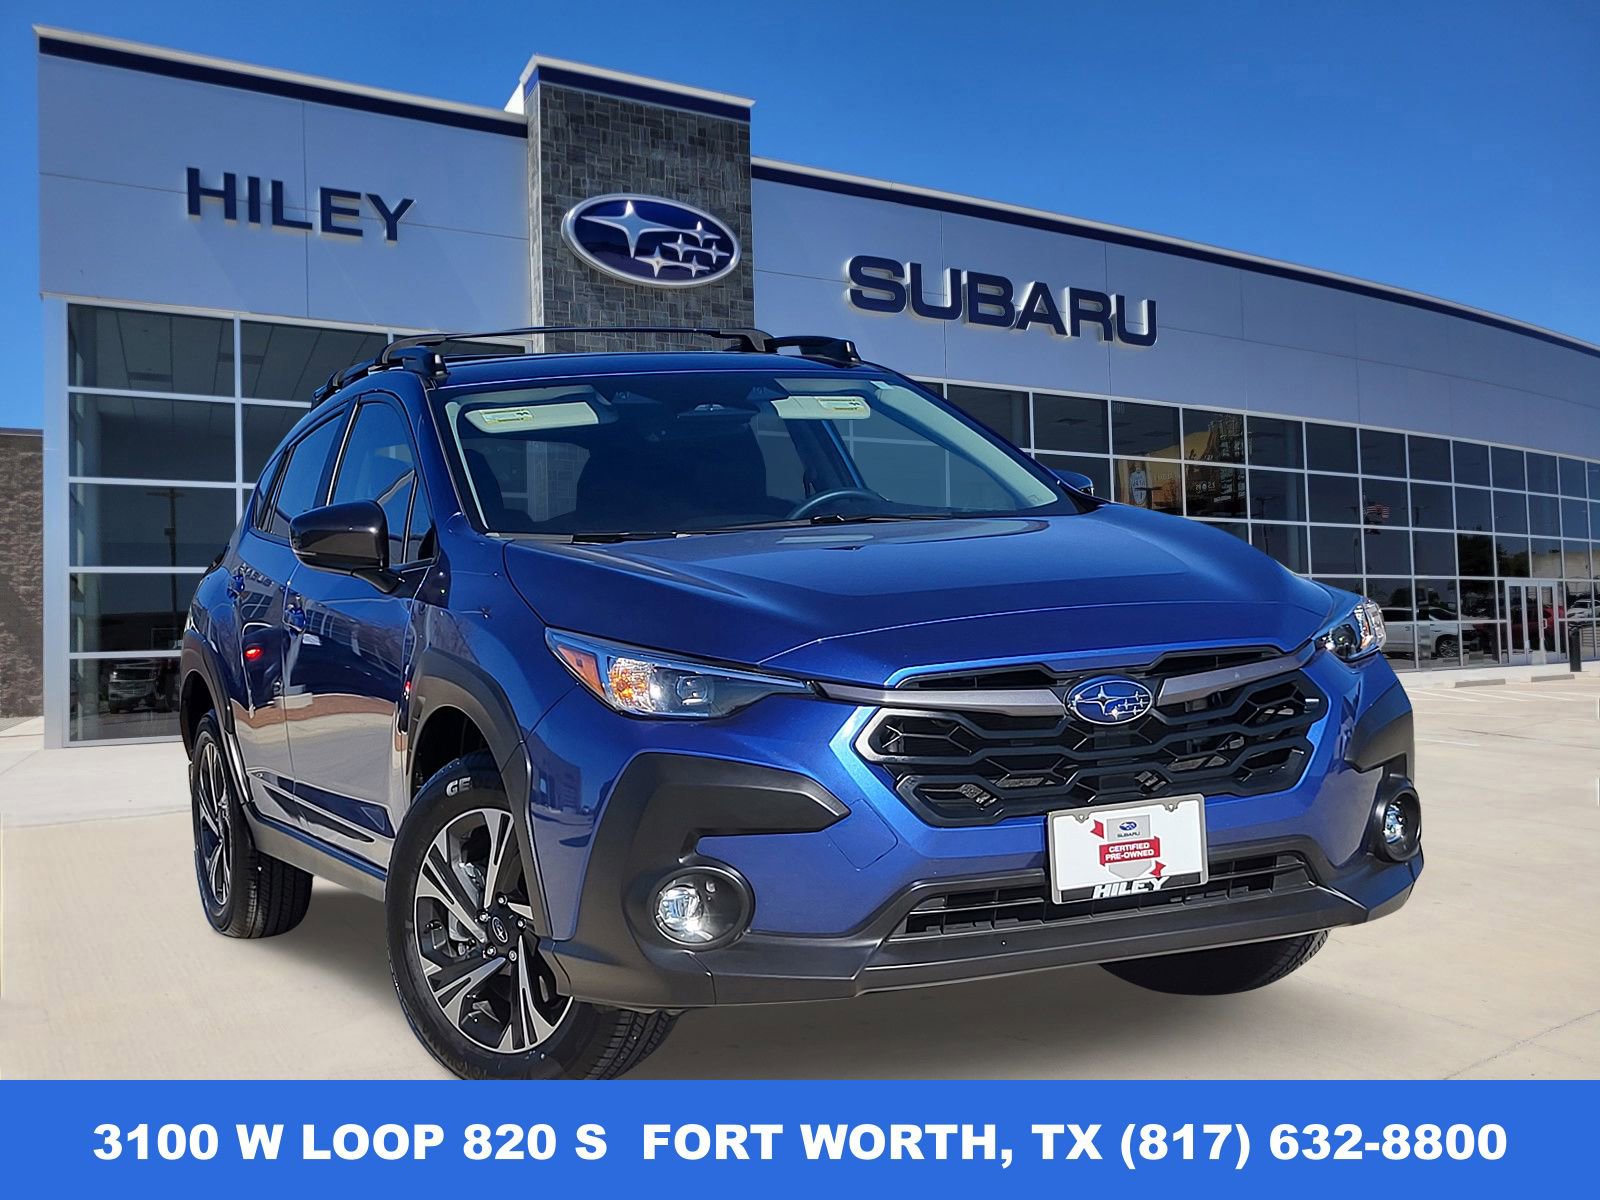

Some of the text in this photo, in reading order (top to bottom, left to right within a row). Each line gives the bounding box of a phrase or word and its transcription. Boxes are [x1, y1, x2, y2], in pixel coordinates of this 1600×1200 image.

[186, 168, 414, 241] HILEY
[847, 255, 1157, 347] SUBARU
[1105, 849, 1154, 861] PRE-OWNED
[1108, 842, 1150, 852] CERTIFIED
[1093, 876, 1170, 899] HILEY
